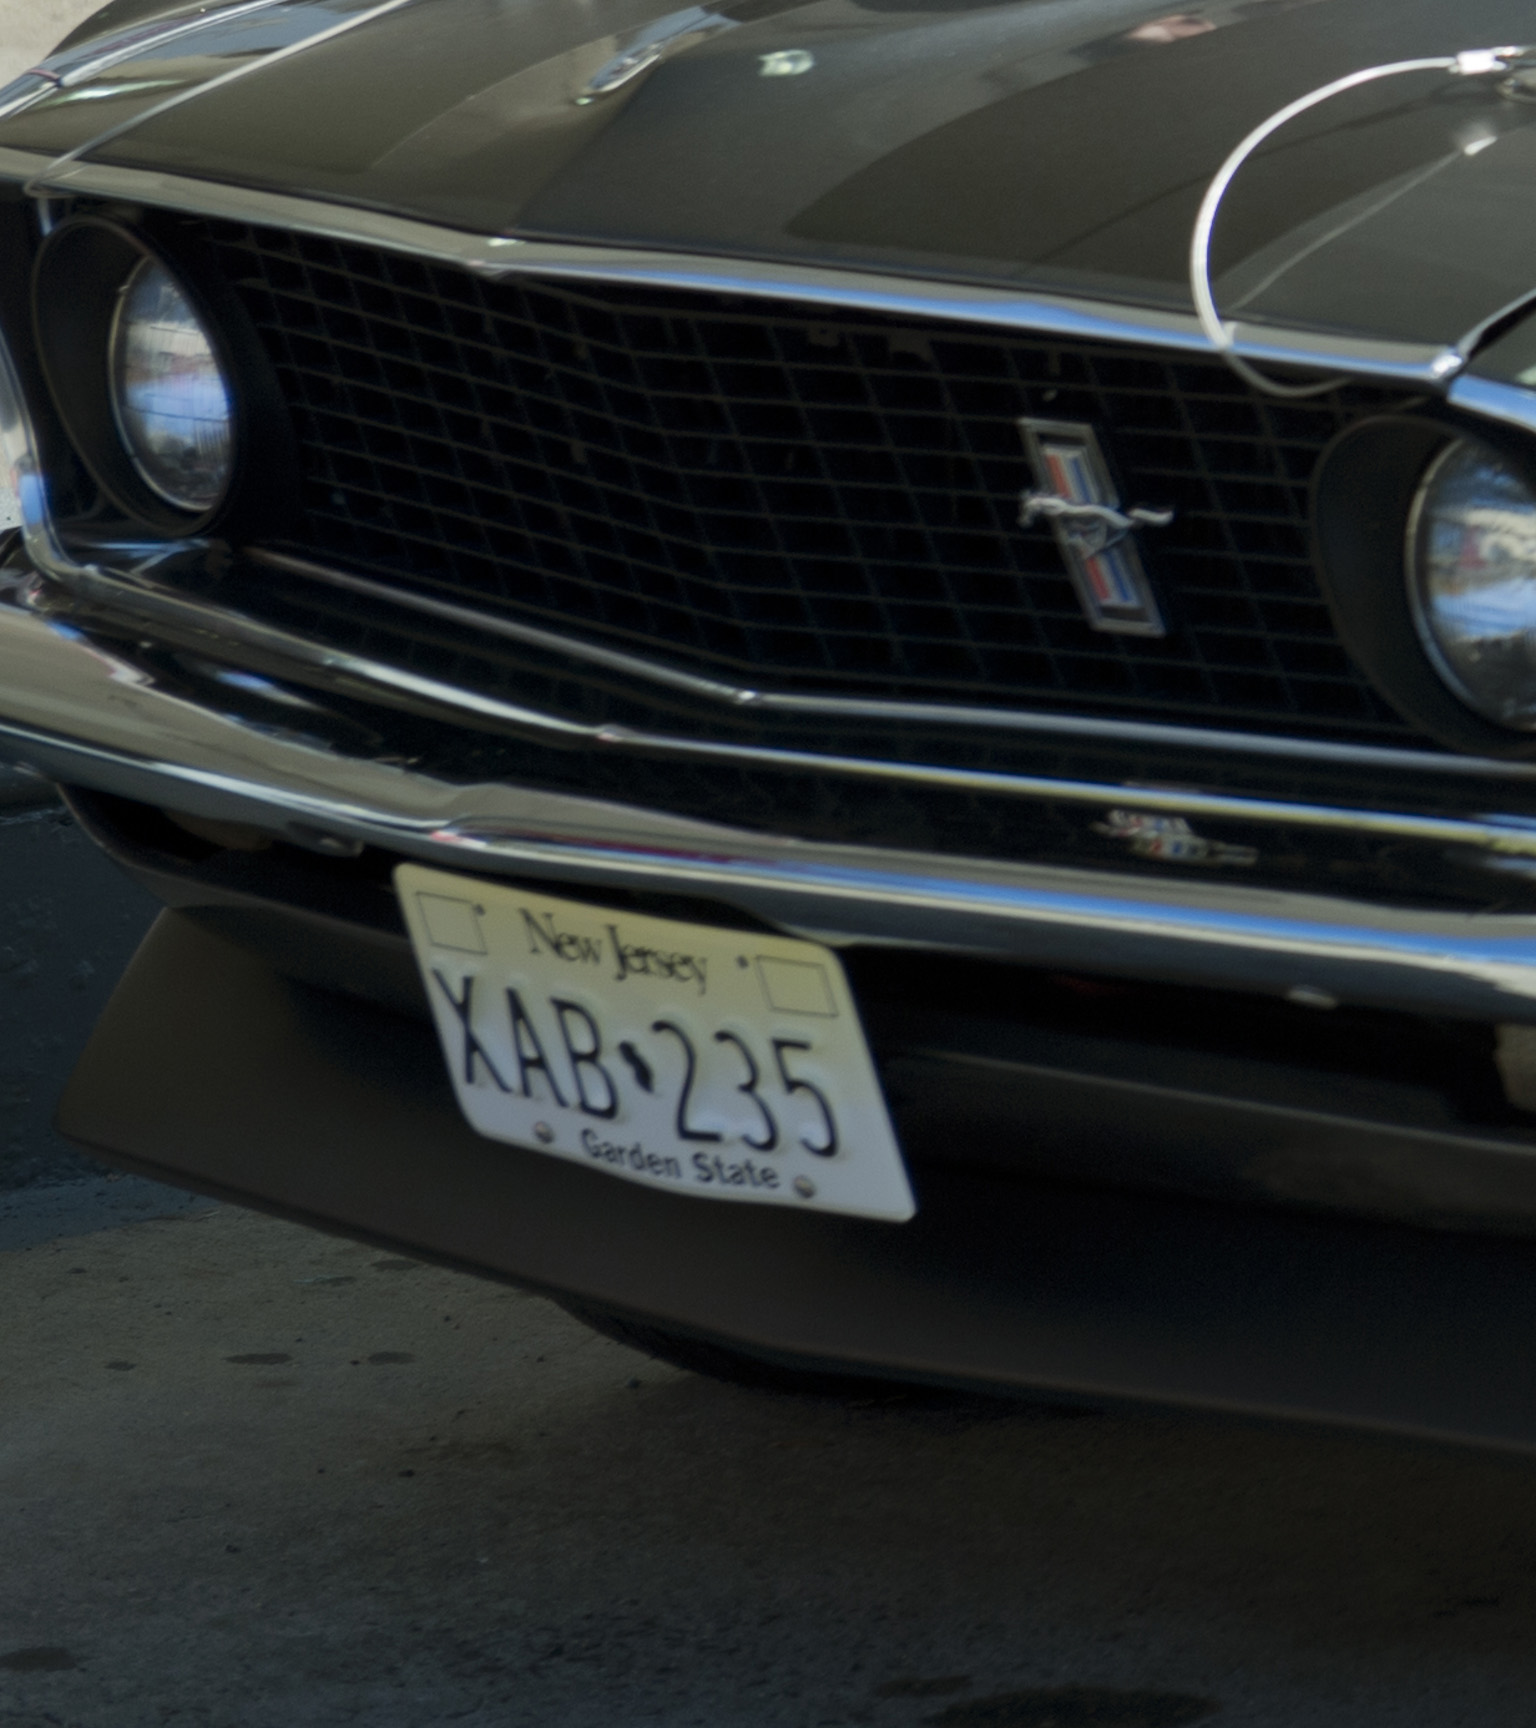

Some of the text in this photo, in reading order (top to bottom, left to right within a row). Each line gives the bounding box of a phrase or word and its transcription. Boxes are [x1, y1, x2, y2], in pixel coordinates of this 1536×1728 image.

[518, 906, 708, 995] New Jersey
[581, 1128, 782, 1191] Garden State
